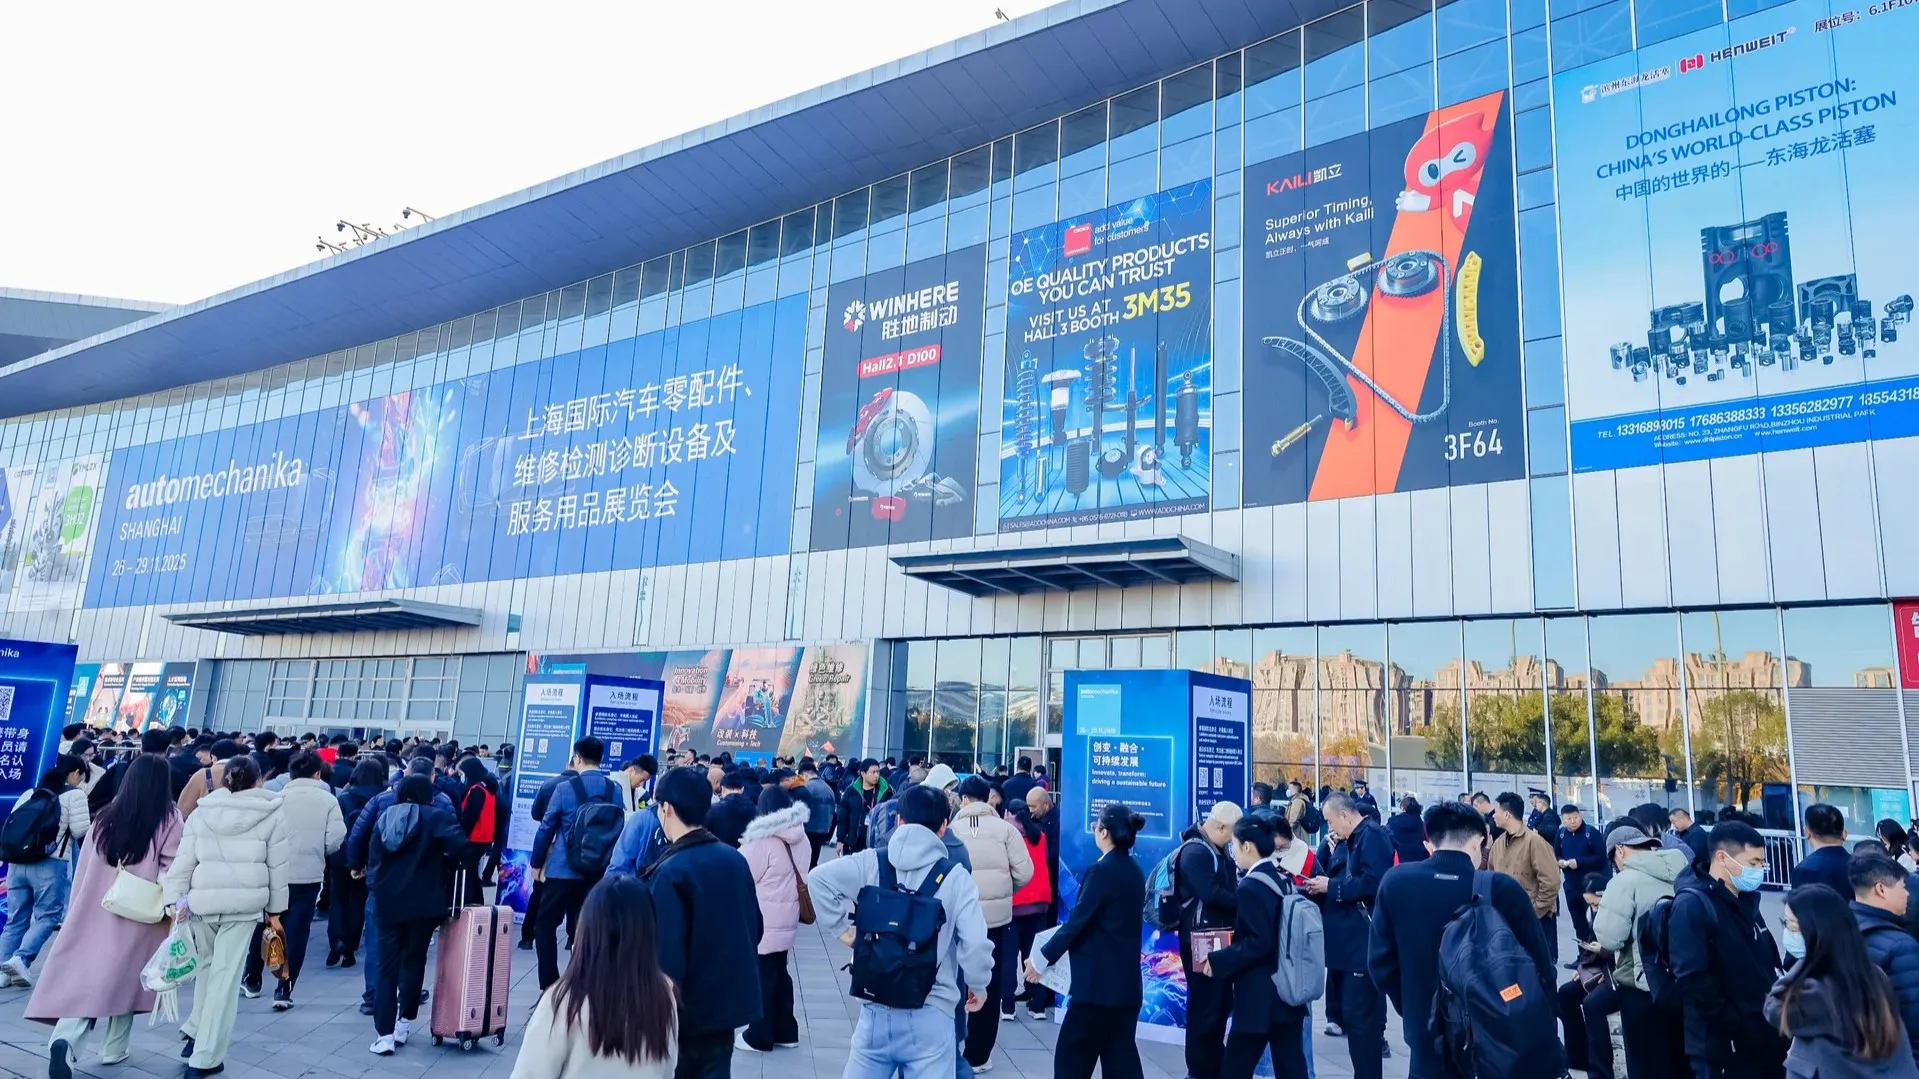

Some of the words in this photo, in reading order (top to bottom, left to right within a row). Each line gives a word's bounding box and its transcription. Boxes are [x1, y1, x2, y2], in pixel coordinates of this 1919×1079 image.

[1710, 30, 1788, 62] HENWEIT
[1625, 99, 1771, 150] DONGHAILONG
[1775, 77, 1857, 111] PISTON:
[1597, 145, 1668, 180] CHINA'S
[1670, 110, 1814, 160] WORLD-CLASS
[1819, 90, 1897, 125] PISTON
[1266, 171, 1312, 196] KAILI
[1313, 163, 1343, 183] 凯立
[1094, 222, 1110, 234] add
[1112, 216, 1134, 229] value
[1265, 206, 1321, 231] Superior
[1323, 195, 1374, 217] Timing,
[1265, 225, 1311, 246] Always
[1314, 216, 1342, 234] with
[1345, 207, 1375, 226] Kaili
[1094, 236, 1105, 246] for
[1107, 225, 1150, 242] customers
[1010, 276, 1034, 297] OE
[1036, 258, 1110, 290] QUALITY
[1112, 232, 1210, 272] PRODUCTS
[1038, 281, 1074, 305] YOU
[1077, 273, 1115, 297] CAN
[1118, 258, 1176, 287] TRUST
[869, 280, 960, 322] WINHERE
[1024, 327, 1058, 344] HALL
[1060, 322, 1068, 337] 3
[1070, 310, 1120, 335] BOOTH
[1122, 281, 1192, 320] 3M35
[1029, 309, 1064, 329] VISIT
[1068, 304, 1087, 321] US
[1090, 298, 1112, 316] AT
[881, 304, 959, 341] 胜地制动
[862, 352, 905, 376] Hall2.1
[907, 347, 937, 366] D100
[517, 362, 752, 441] 上海国际汽车零配件、
[1770, 395, 1854, 419] 13356282977
[1468, 419, 1488, 428] Booth
[1488, 418, 1500, 426] No.
[1806, 412, 1853, 424] INDUSTRIAL
[512, 418, 738, 488] 维修检测诊断设备及
[1444, 428, 1503, 461] 3F64
[125, 450, 303, 511] automechanika
[506, 479, 680, 537] 服务用品展览会
[119, 515, 182, 541] SHANGHAI
[112, 559, 126, 577] 26
[135, 552, 188, 575] 29.11.2025
[540, 687, 564, 697] 入场流程
[609, 691, 639, 701] 入场流程
[1208, 695, 1233, 709] 入场流程
[1092, 755, 1139, 768] 可持续发展
[1091, 777, 1111, 786] driving
[1116, 778, 1148, 787] sustainable
[1148, 780, 1167, 788] future
